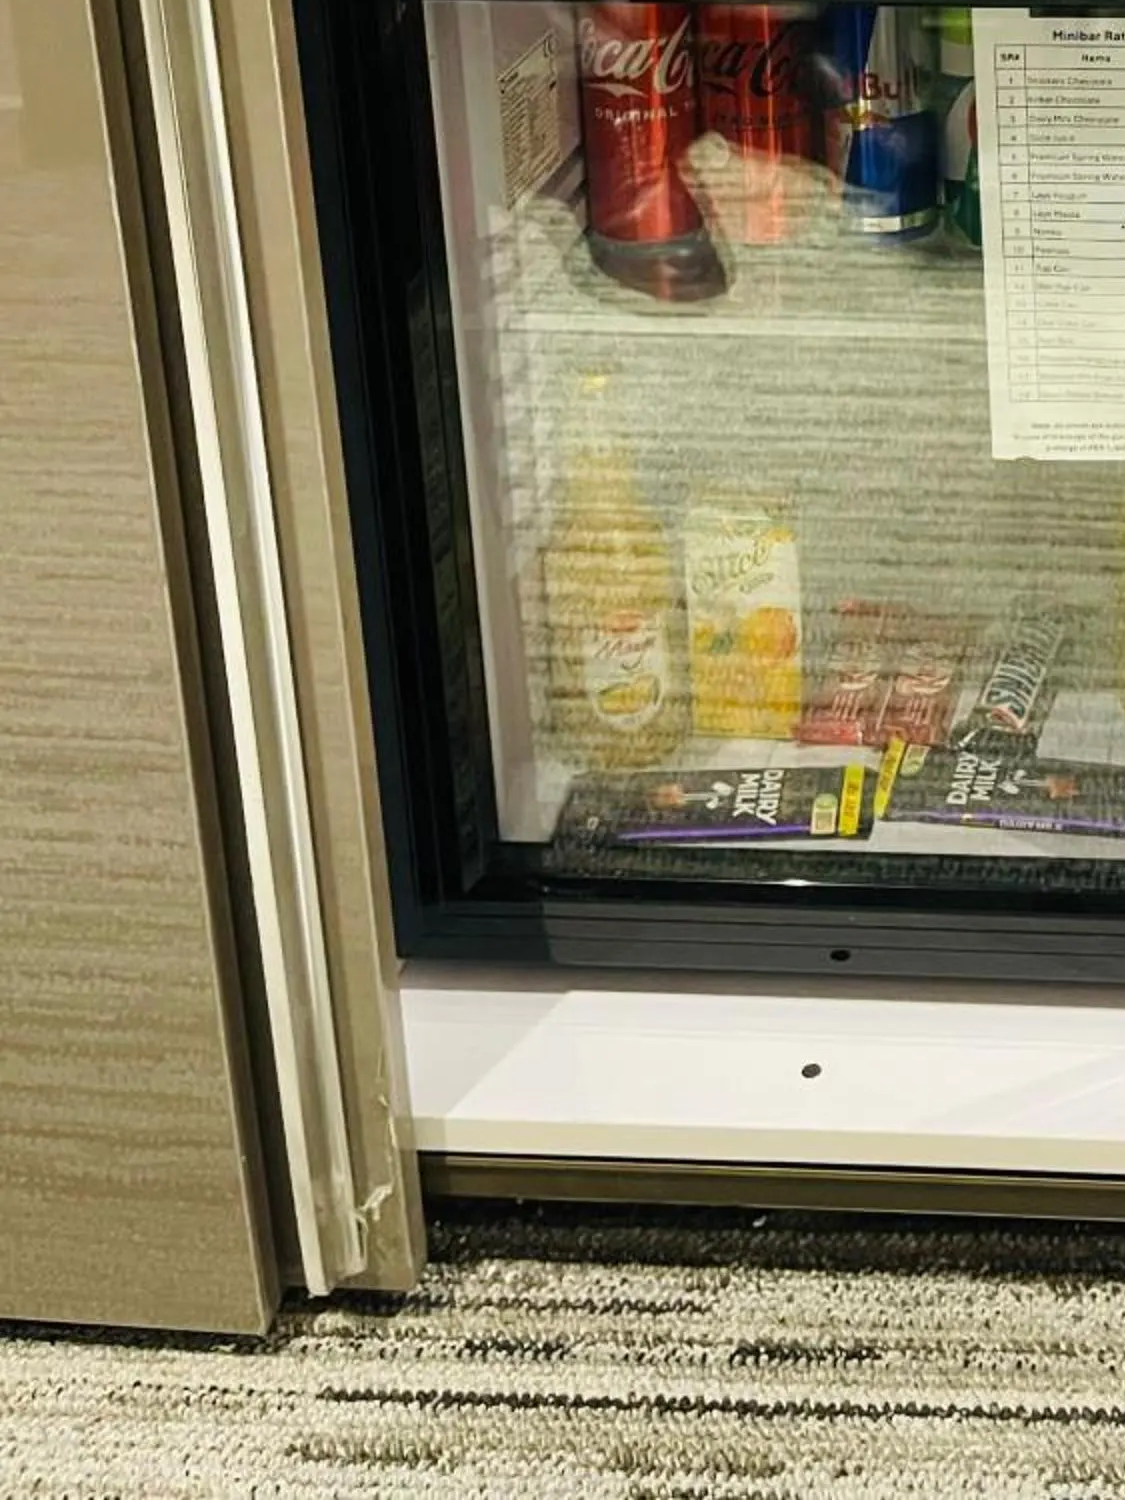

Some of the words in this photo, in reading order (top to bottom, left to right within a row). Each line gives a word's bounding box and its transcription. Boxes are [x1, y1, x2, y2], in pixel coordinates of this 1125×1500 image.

[1053, 31, 1101, 43] Minibar
[1081, 54, 1111, 63] Items
[731, 772, 753, 818] MILK
[757, 769, 785, 826] DAIRY
[946, 750, 980, 806] DAIRY
[969, 758, 999, 801] MILK
